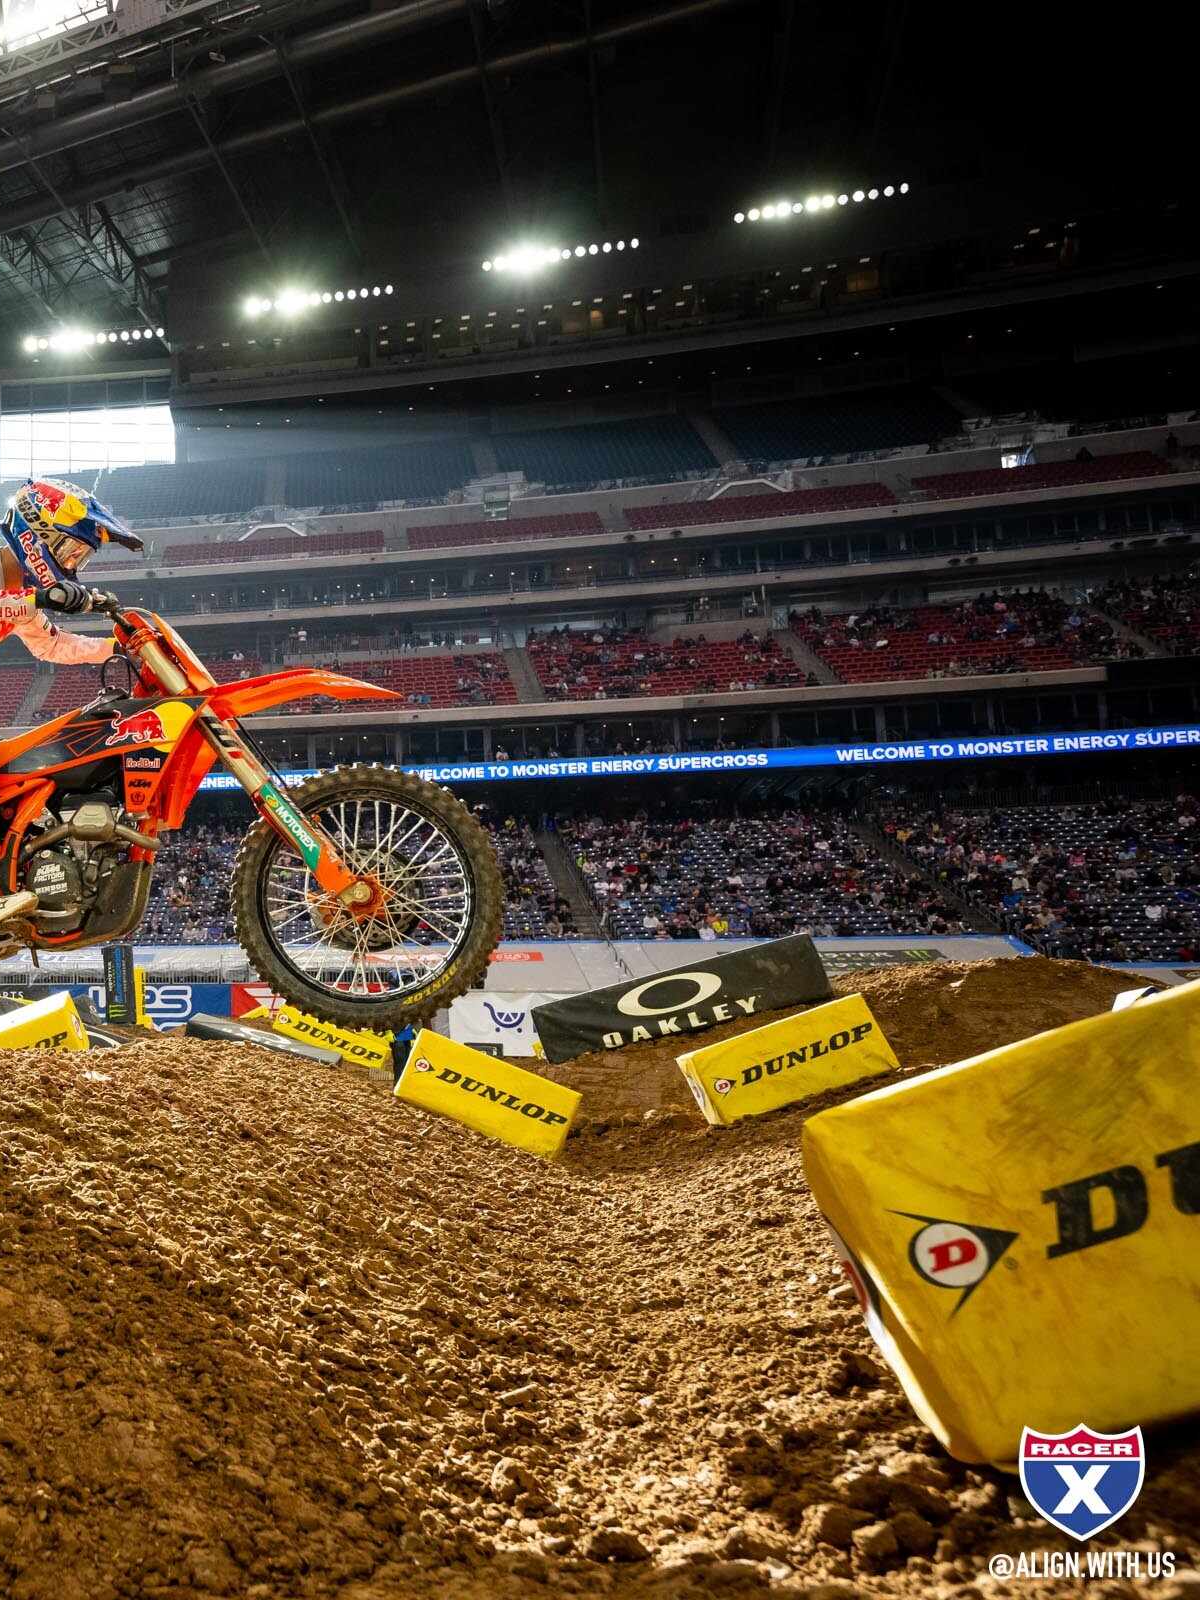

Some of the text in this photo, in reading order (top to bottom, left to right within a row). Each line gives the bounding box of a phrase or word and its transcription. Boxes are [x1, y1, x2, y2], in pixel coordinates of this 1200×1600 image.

[18, 530, 58, 590] Red Bull
[5, 605, 27, 618] Bull
[126, 758, 160, 768] Red Bull
[836, 730, 1200, 762] WELCOME TO MONSTER ENERGY SUPER
[128, 779, 152, 788] KTM
[413, 753, 768, 781] WELCOME TO MONSTER ENERGY SUPERCROSS
[275, 805, 318, 853] MOTOREX
[34, 871, 65, 883] FACTORY
[36, 864, 61, 876] KTM
[403, 964, 457, 1005] DUNLOP
[602, 996, 756, 1048] OAKLEY
[294, 1021, 383, 1063] DUNLOP
[741, 1022, 873, 1086] DUNLOP
[436, 1067, 568, 1128] DUNLOP
